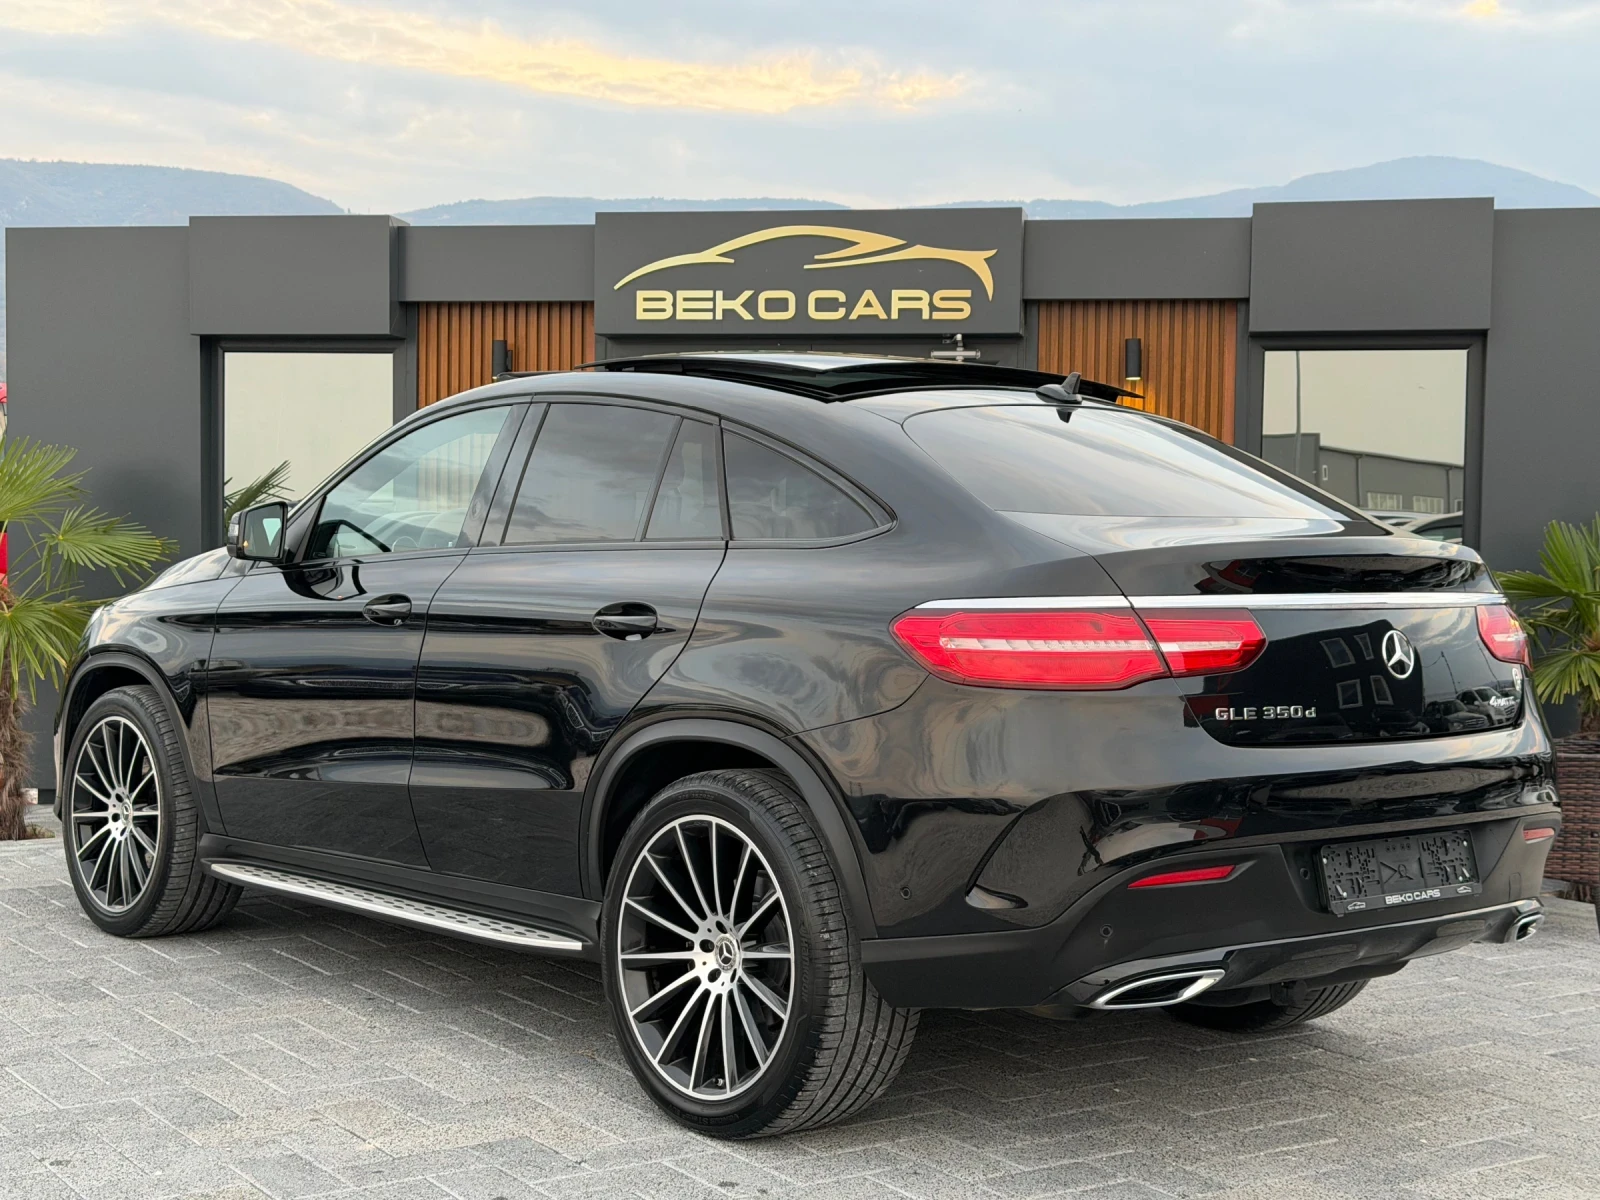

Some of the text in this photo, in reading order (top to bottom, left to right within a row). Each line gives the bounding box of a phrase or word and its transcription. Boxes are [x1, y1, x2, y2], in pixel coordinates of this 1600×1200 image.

[636, 289, 972, 321] BEKO CARS
[1215, 707, 1257, 720] GLE
[1385, 889, 1440, 904] BEKO CARS
